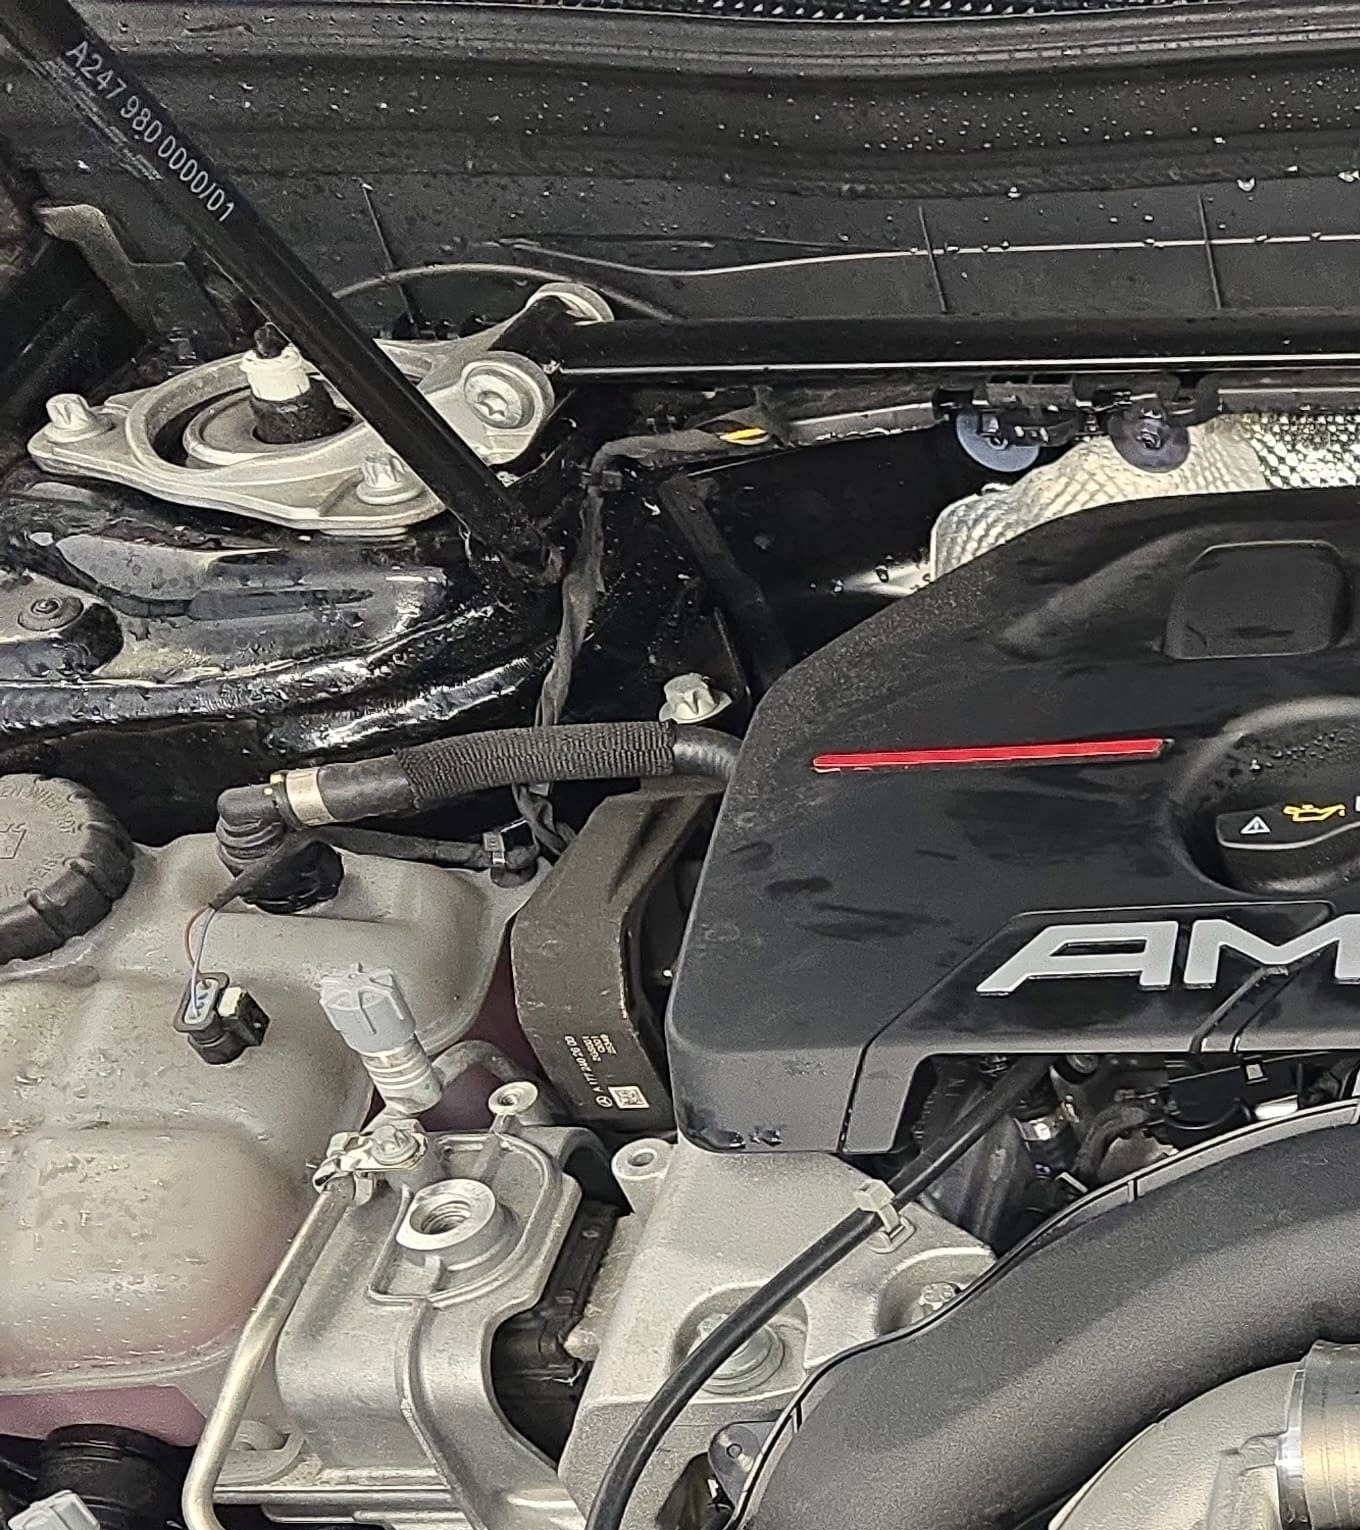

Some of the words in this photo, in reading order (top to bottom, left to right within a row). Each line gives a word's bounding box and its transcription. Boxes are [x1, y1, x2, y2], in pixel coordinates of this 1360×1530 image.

[65, 41, 127, 99] A247
[120, 96, 162, 142] 980
[157, 135, 235, 221] 0000/01
